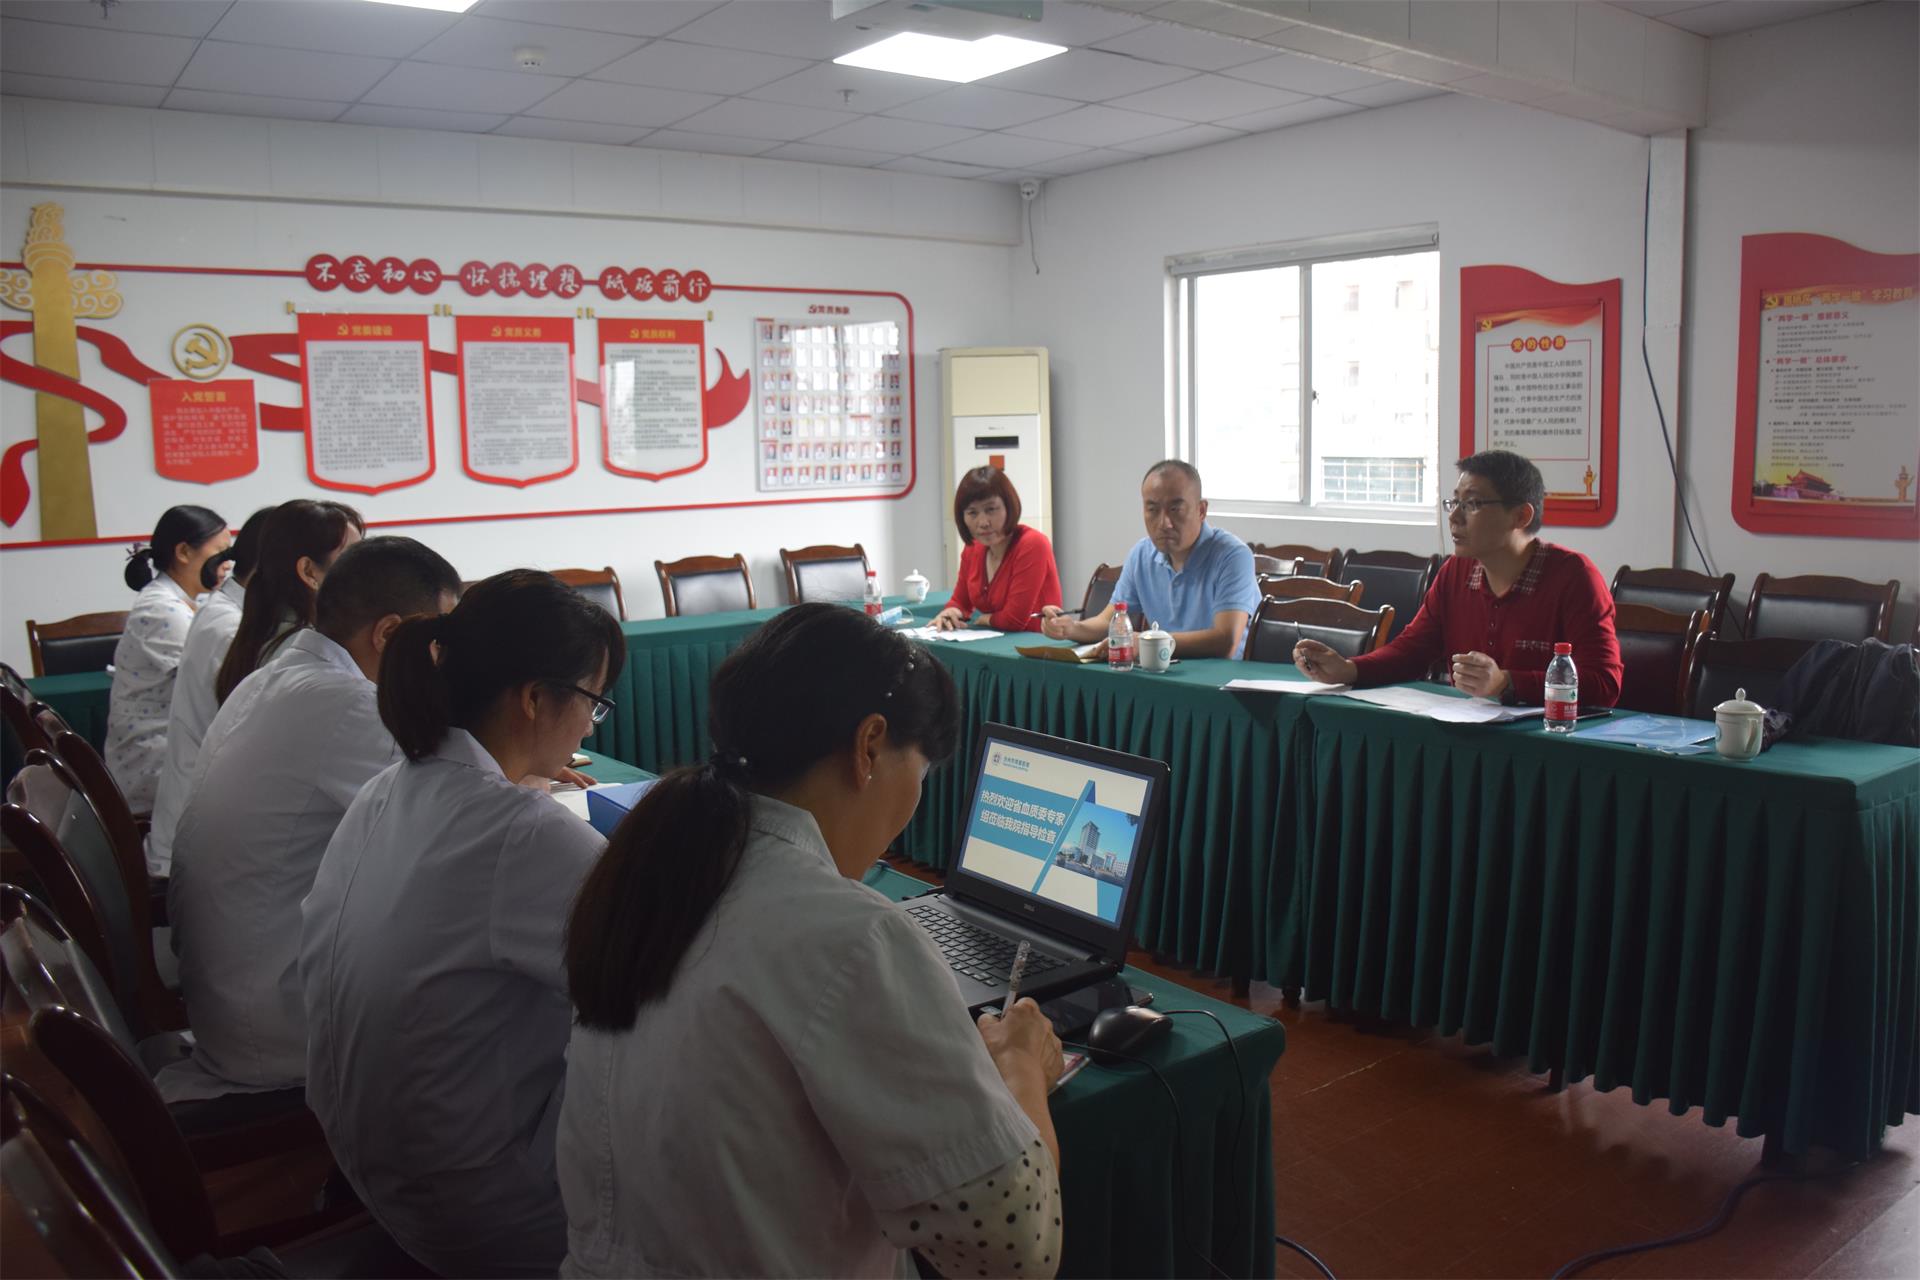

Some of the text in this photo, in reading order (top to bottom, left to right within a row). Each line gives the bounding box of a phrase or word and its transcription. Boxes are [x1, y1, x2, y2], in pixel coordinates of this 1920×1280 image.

[314, 259, 707, 298] 不忘初心 怀揣理想 砥砺前行
[1512, 336, 1566, 352] 党的性质
[980, 789, 1066, 826] 热烈欢迎省血质委专家
[979, 809, 1057, 844] 组莅临我院指导检查
